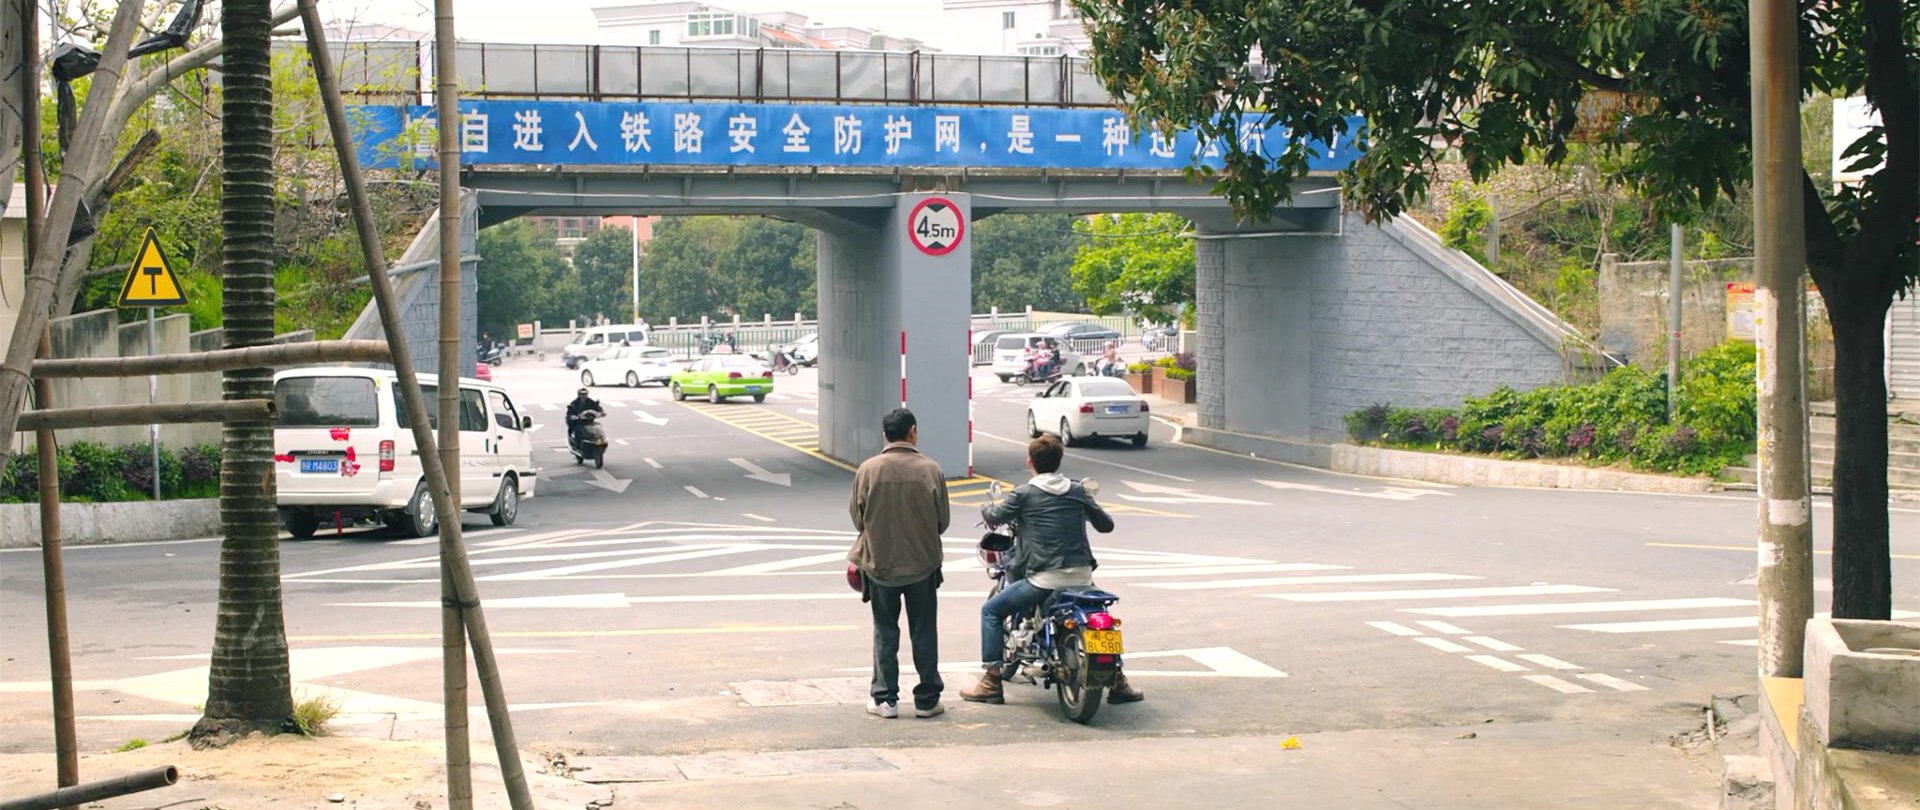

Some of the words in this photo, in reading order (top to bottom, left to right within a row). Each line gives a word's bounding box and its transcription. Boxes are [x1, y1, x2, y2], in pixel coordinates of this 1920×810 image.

[405, 109, 1338, 159] 自进入铁路安全防护网，是一种违法行！
[916, 215, 956, 238] 4.5m
